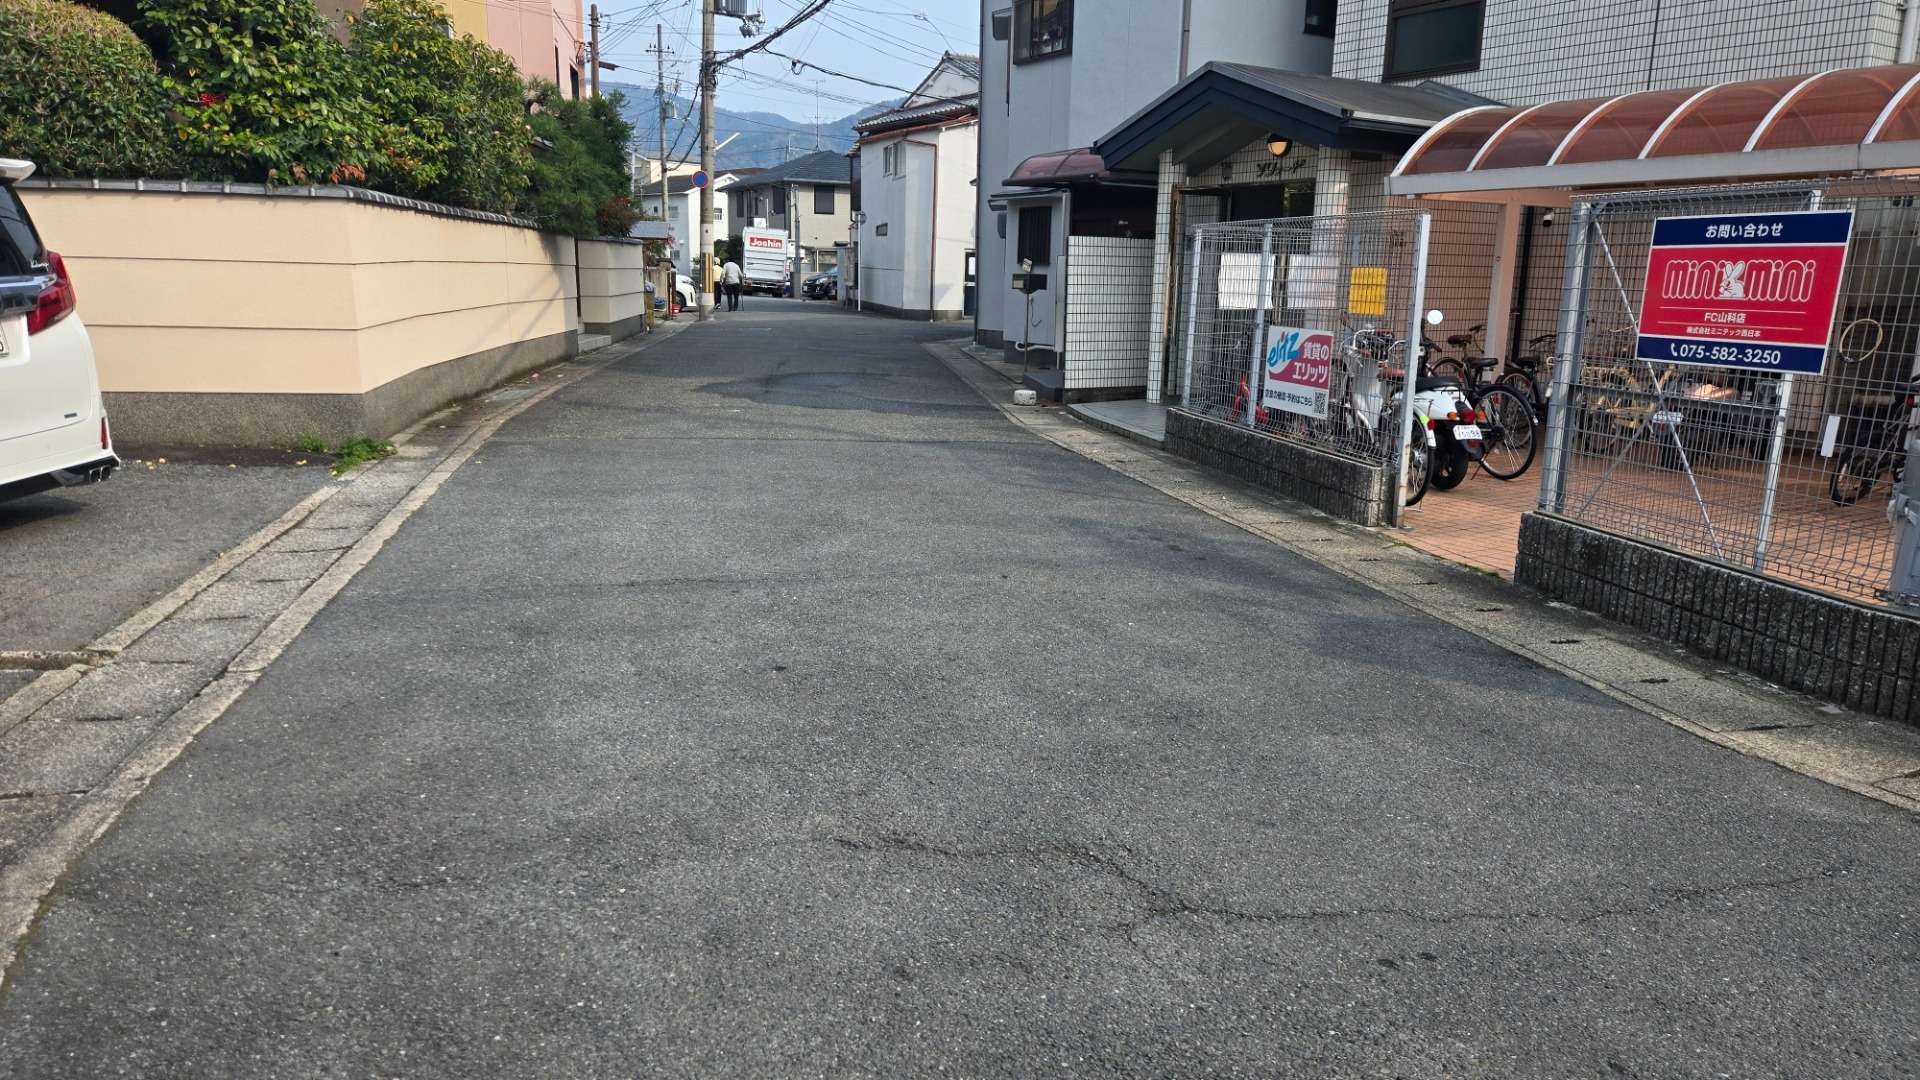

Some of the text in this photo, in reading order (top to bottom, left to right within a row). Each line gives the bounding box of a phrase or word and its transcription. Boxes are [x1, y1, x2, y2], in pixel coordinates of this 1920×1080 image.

[1705, 223, 1784, 239] お問い合わせ
[1704, 312, 1747, 324] FC山科店
[1304, 342, 1330, 361] 賃貸の
[1679, 342, 1782, 366] 075-582-3250
[1292, 361, 1329, 384] エリッツ
